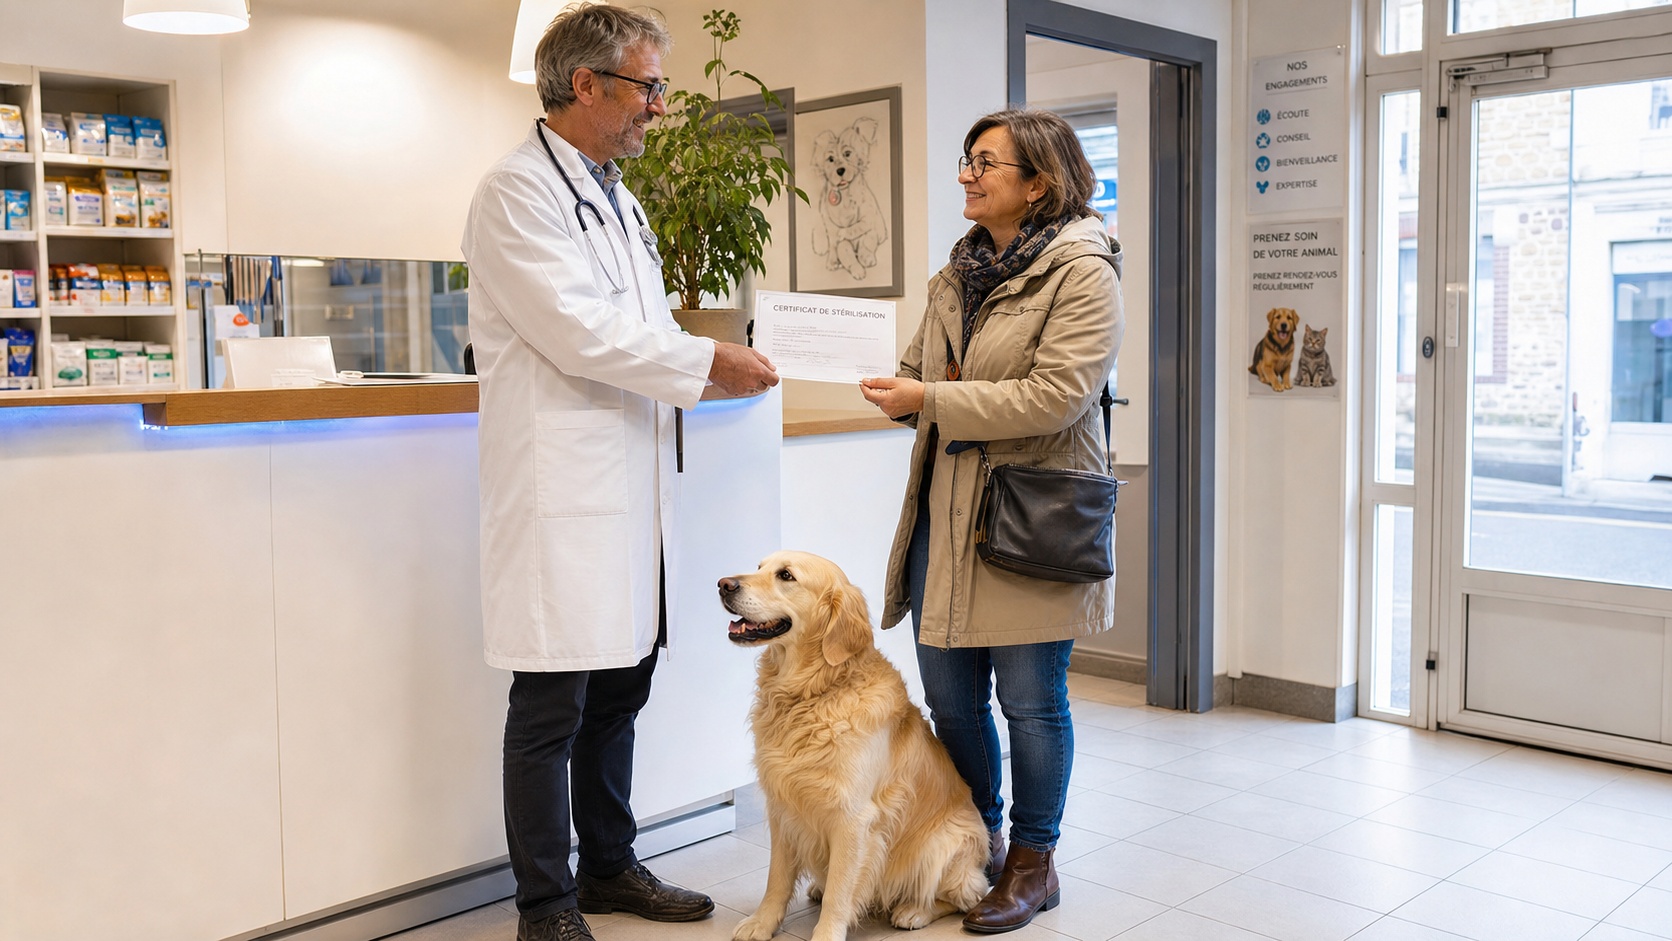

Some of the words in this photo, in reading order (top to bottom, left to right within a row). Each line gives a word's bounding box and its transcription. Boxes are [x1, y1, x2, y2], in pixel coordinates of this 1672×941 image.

[1286, 60, 1308, 72] NOS
[1265, 75, 1328, 91] ENGAGEMENTS
[1276, 108, 1310, 120] ÉCOUTE
[1276, 132, 1311, 144] CONSEIL
[1276, 154, 1338, 167] BIENVEILLANCE
[1276, 179, 1318, 191] EXPERTISE
[1253, 232, 1291, 243] PRENEZ
[1294, 231, 1318, 242] SOIN
[1253, 249, 1266, 259] DE
[1267, 248, 1298, 259] VOTRE
[1301, 247, 1338, 257] ANIMAL
[1252, 272, 1282, 280] PRENEZ
[1283, 270, 1338, 280] RENDEZ-VOUS
[773, 304, 817, 314] CERTIFICAT
[819, 307, 829, 315] DE
[831, 308, 886, 319] STÉRILISATION
